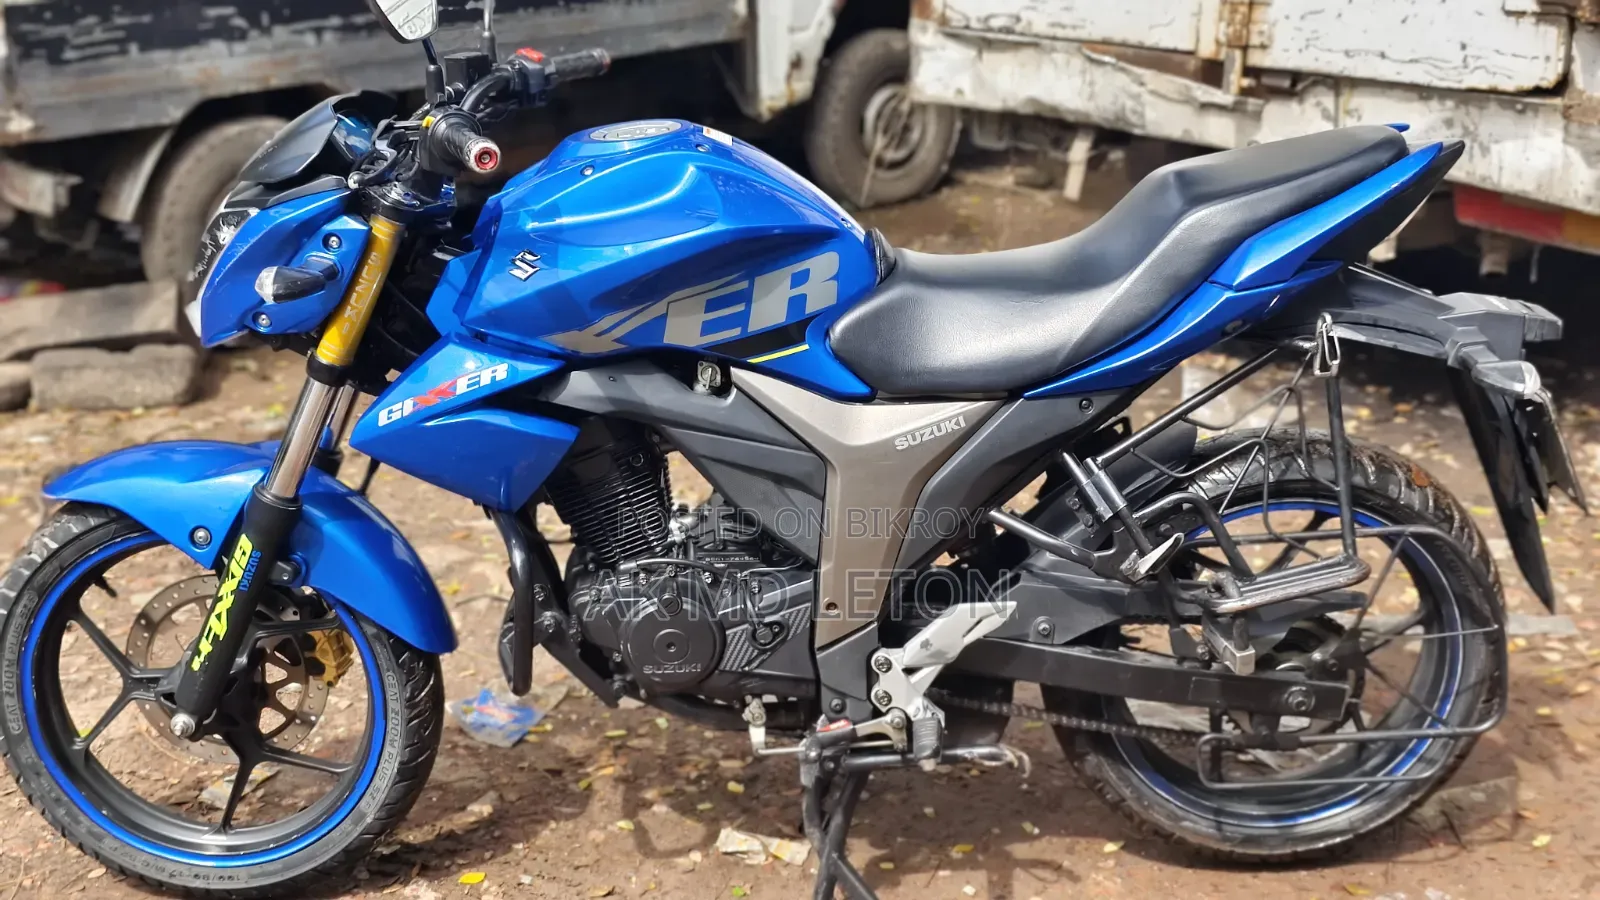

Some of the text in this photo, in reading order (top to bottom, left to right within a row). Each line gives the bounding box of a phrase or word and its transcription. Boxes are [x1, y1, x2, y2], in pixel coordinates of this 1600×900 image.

[342, 251, 382, 335] SUZUKI
[377, 362, 509, 427] GIXXER
[894, 415, 967, 450] SUZUKI
[238, 549, 262, 592] SUZUKI
[643, 663, 702, 674] SUZUKI
[386, 673, 400, 704] CEAT
[379, 750, 394, 783] PLUS
